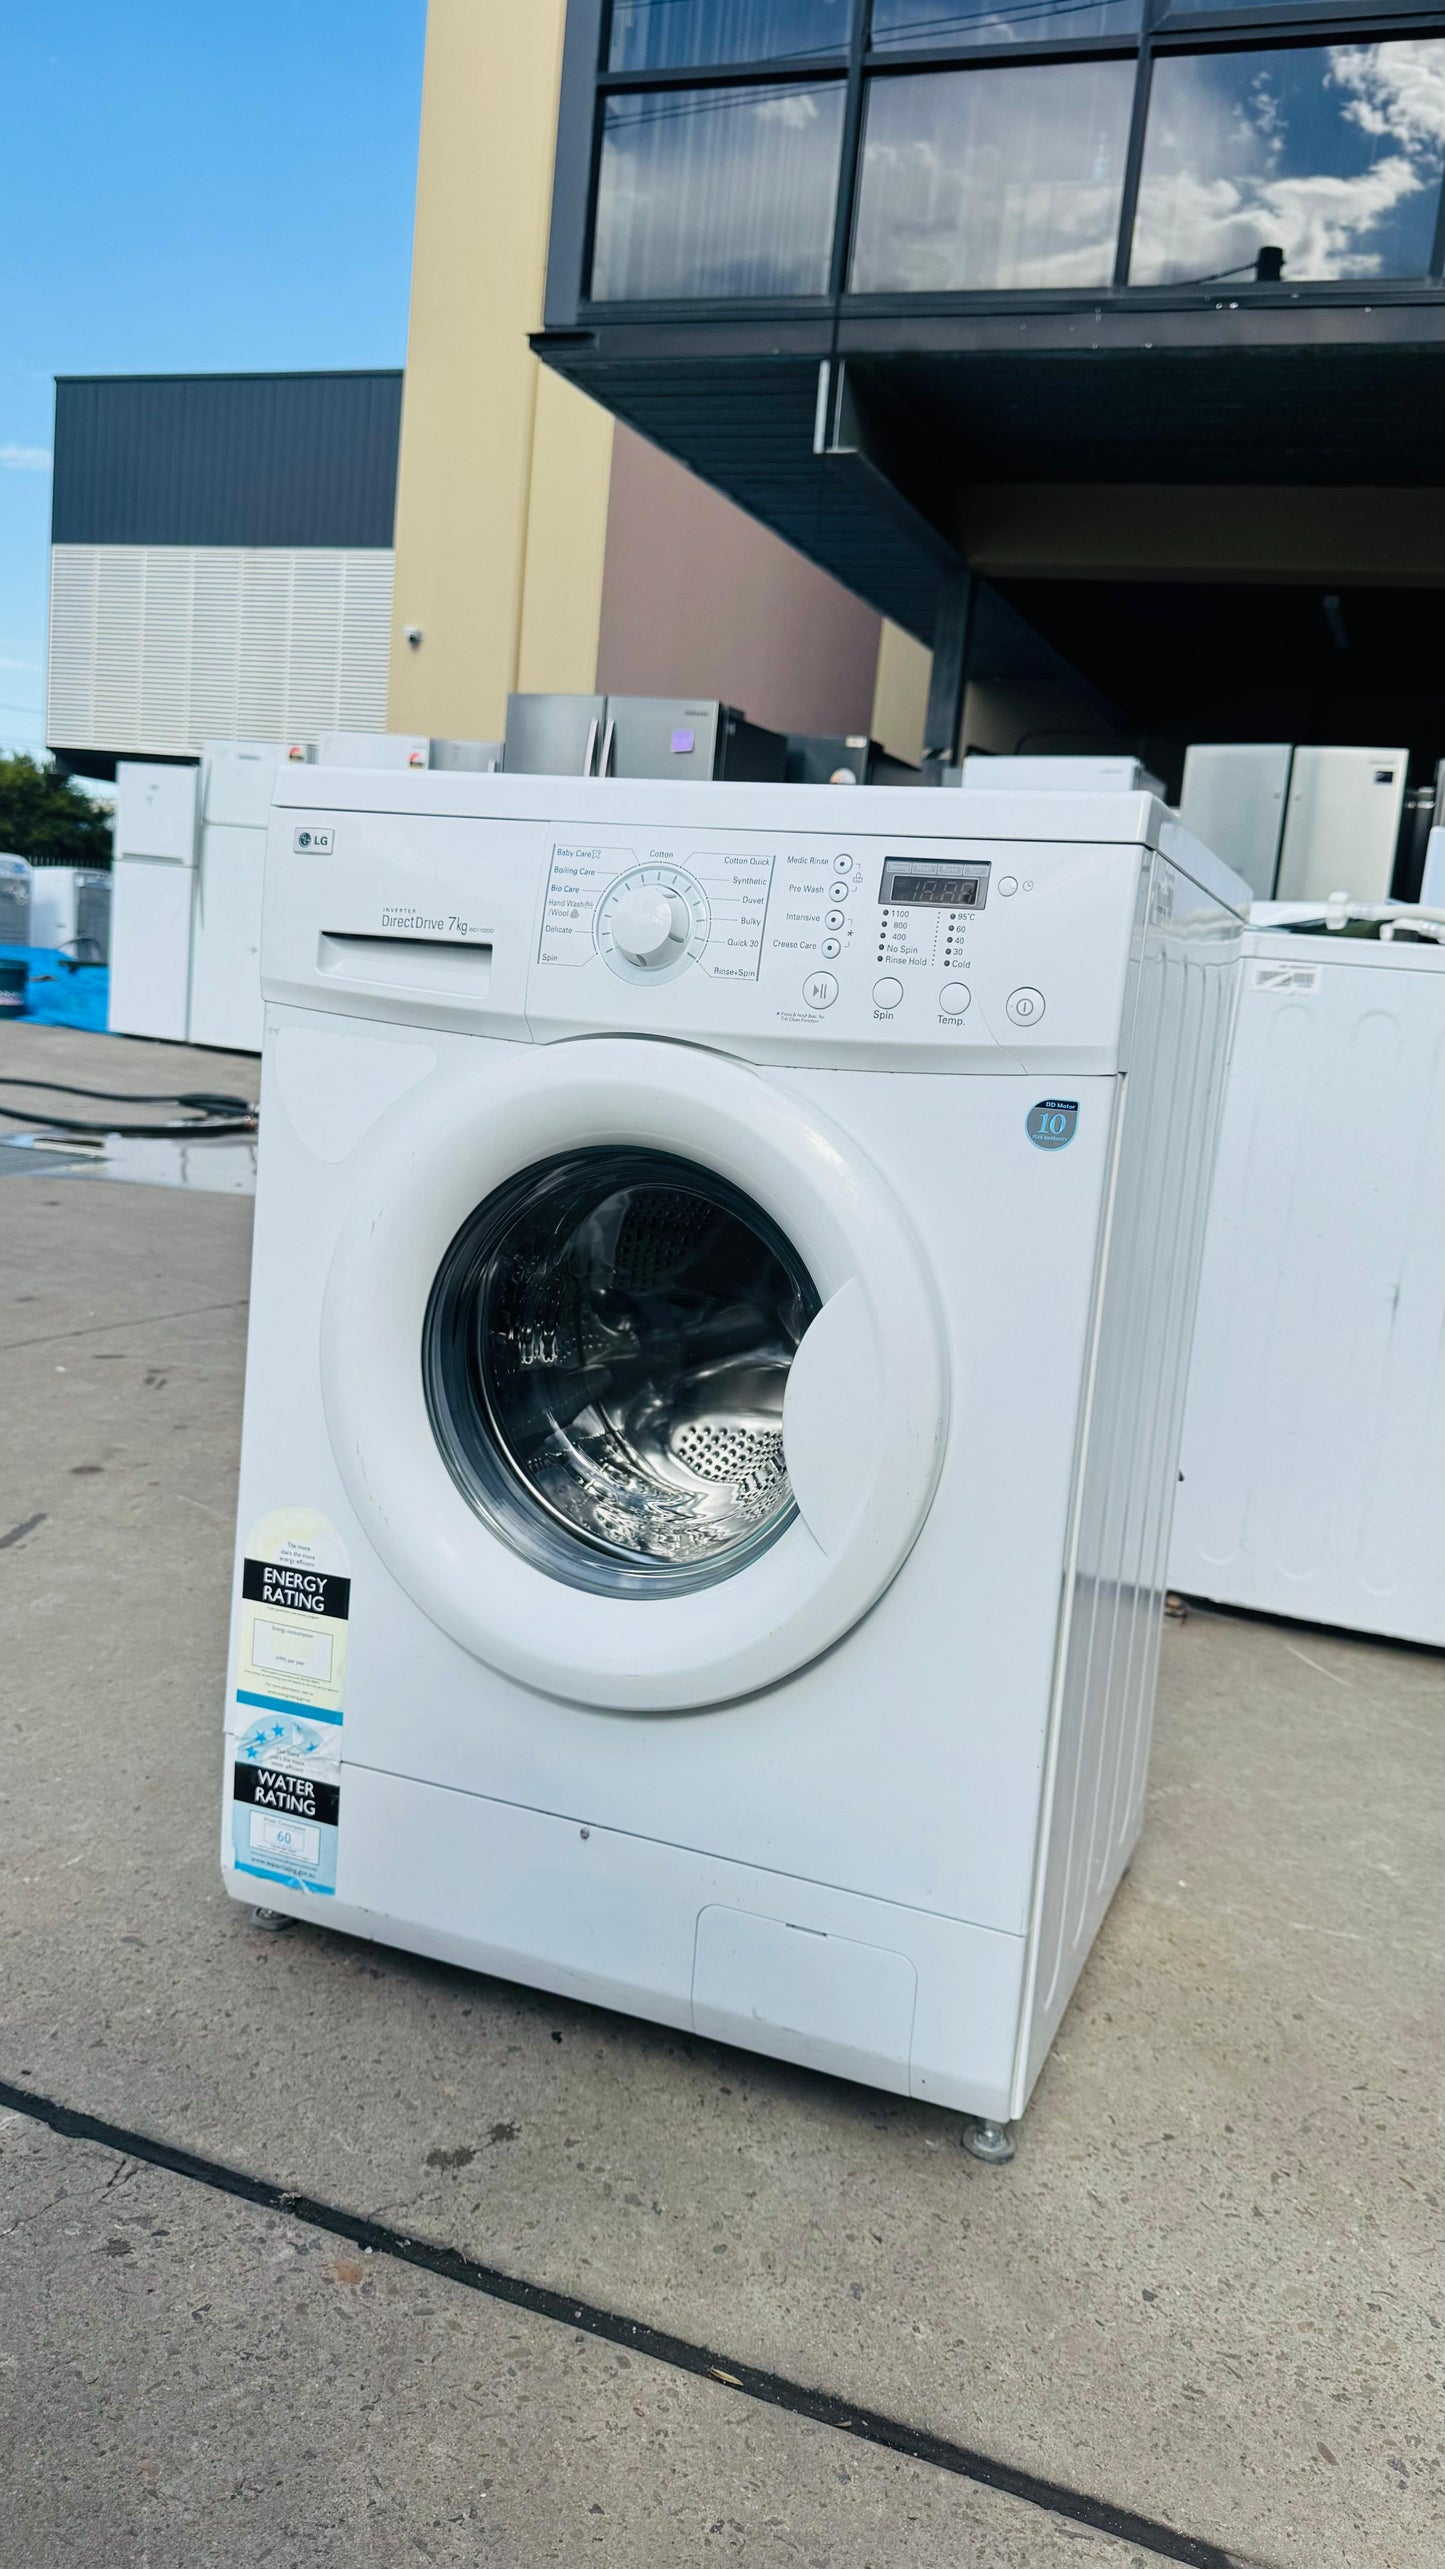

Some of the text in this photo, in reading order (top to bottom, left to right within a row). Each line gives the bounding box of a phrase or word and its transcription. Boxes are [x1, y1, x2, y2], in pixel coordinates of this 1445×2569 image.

[314, 836, 328, 846] LG
[557, 848, 591, 858] Baby Care
[650, 850, 673, 858] Cotton
[724, 856, 770, 866] Cotton Quick
[787, 856, 829, 865] Medic Rinse
[554, 866, 595, 876] Boiling Care
[733, 876, 767, 886] Synthetic
[564, 885, 580, 893] Care
[804, 885, 824, 894] Wash
[549, 899, 584, 908] Hand Wash
[742, 896, 764, 905] Duvet
[548, 909, 569, 917] /Wool
[786, 912, 820, 922] Intensive
[891, 910, 910, 918] 1100
[957, 913, 976, 921] 95°C
[448, 916, 468, 935] 7kg
[741, 917, 761, 927] Bulky
[545, 925, 573, 934] Delicate
[892, 933, 906, 941] 400
[727, 939, 759, 948] Quick 30
[773, 939, 817, 949] Crease Care
[886, 945, 918, 954] No Spin
[953, 948, 963, 956] 30
[542, 954, 558, 962] Spin
[885, 956, 927, 966] Rinse Hold
[952, 960, 971, 969] Cold
[714, 967, 755, 977] Rinse+Spin
[873, 1010, 894, 1021] Spin
[938, 1015, 966, 1026] Temp.
[1037, 1112, 1066, 1135] 10
[263, 1567, 328, 1594] ENERGY
[263, 1585, 325, 1612] RATING
[257, 1769, 315, 1798] WATER
[254, 1786, 316, 1816] RATING
[277, 1830, 292, 1844] 60
